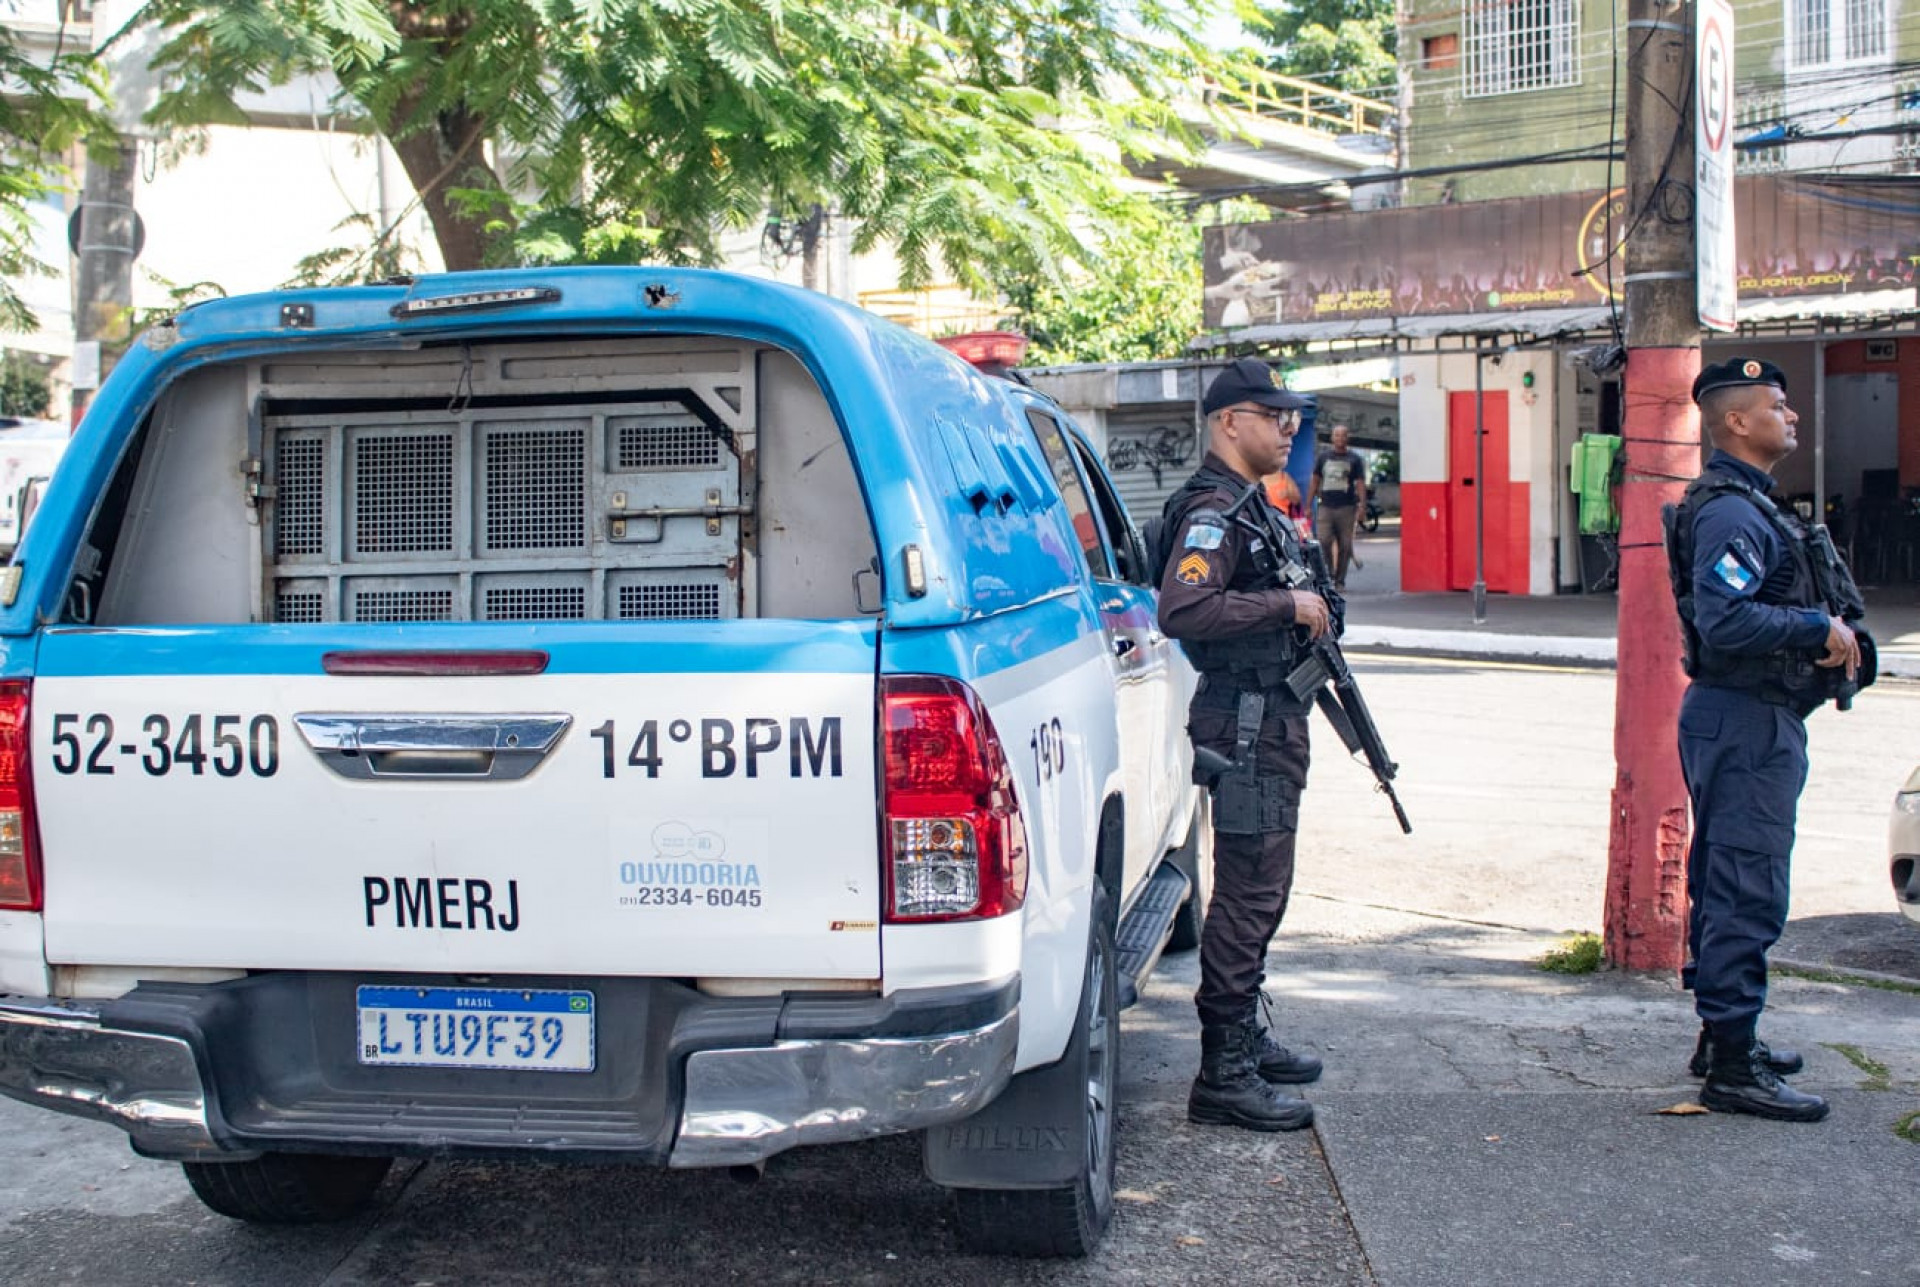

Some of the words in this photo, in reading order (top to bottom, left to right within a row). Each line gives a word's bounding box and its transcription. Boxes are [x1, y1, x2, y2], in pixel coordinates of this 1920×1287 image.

[1709, 46, 1720, 121] E
[1869, 344, 1893, 355] WC
[52, 713, 279, 777] 52-3450
[1031, 716, 1064, 787] 190
[620, 862, 760, 886] OUVIDORIA
[363, 876, 520, 932] PMERJ
[638, 887, 762, 907] 2334-6045
[456, 997, 494, 1008] BRASIL
[366, 1045, 378, 1058] BR
[379, 1013, 563, 1059] LTU9F39
